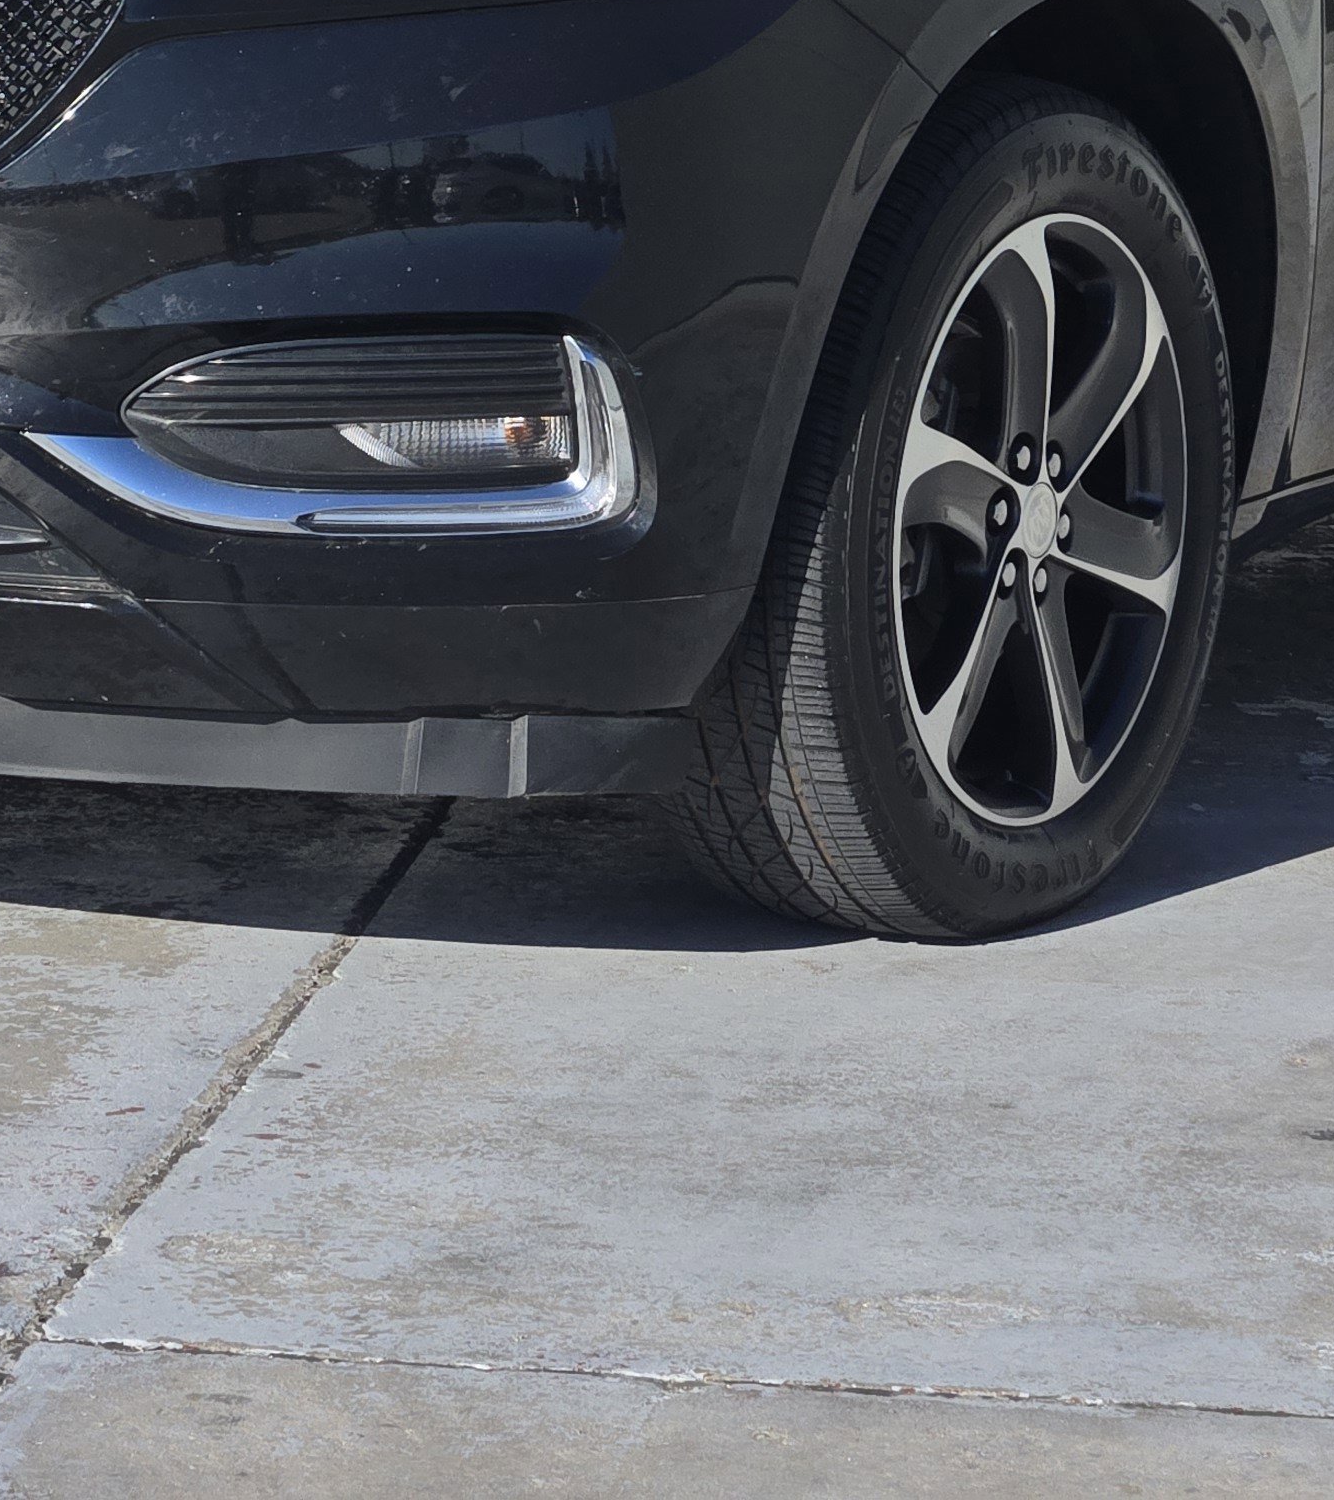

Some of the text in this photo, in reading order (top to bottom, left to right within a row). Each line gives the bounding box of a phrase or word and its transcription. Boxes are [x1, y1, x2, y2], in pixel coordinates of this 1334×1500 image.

[1021, 141, 1183, 244] Firestone
[874, 434, 899, 699] DESTINATION
[1213, 350, 1235, 597] DESTINATION
